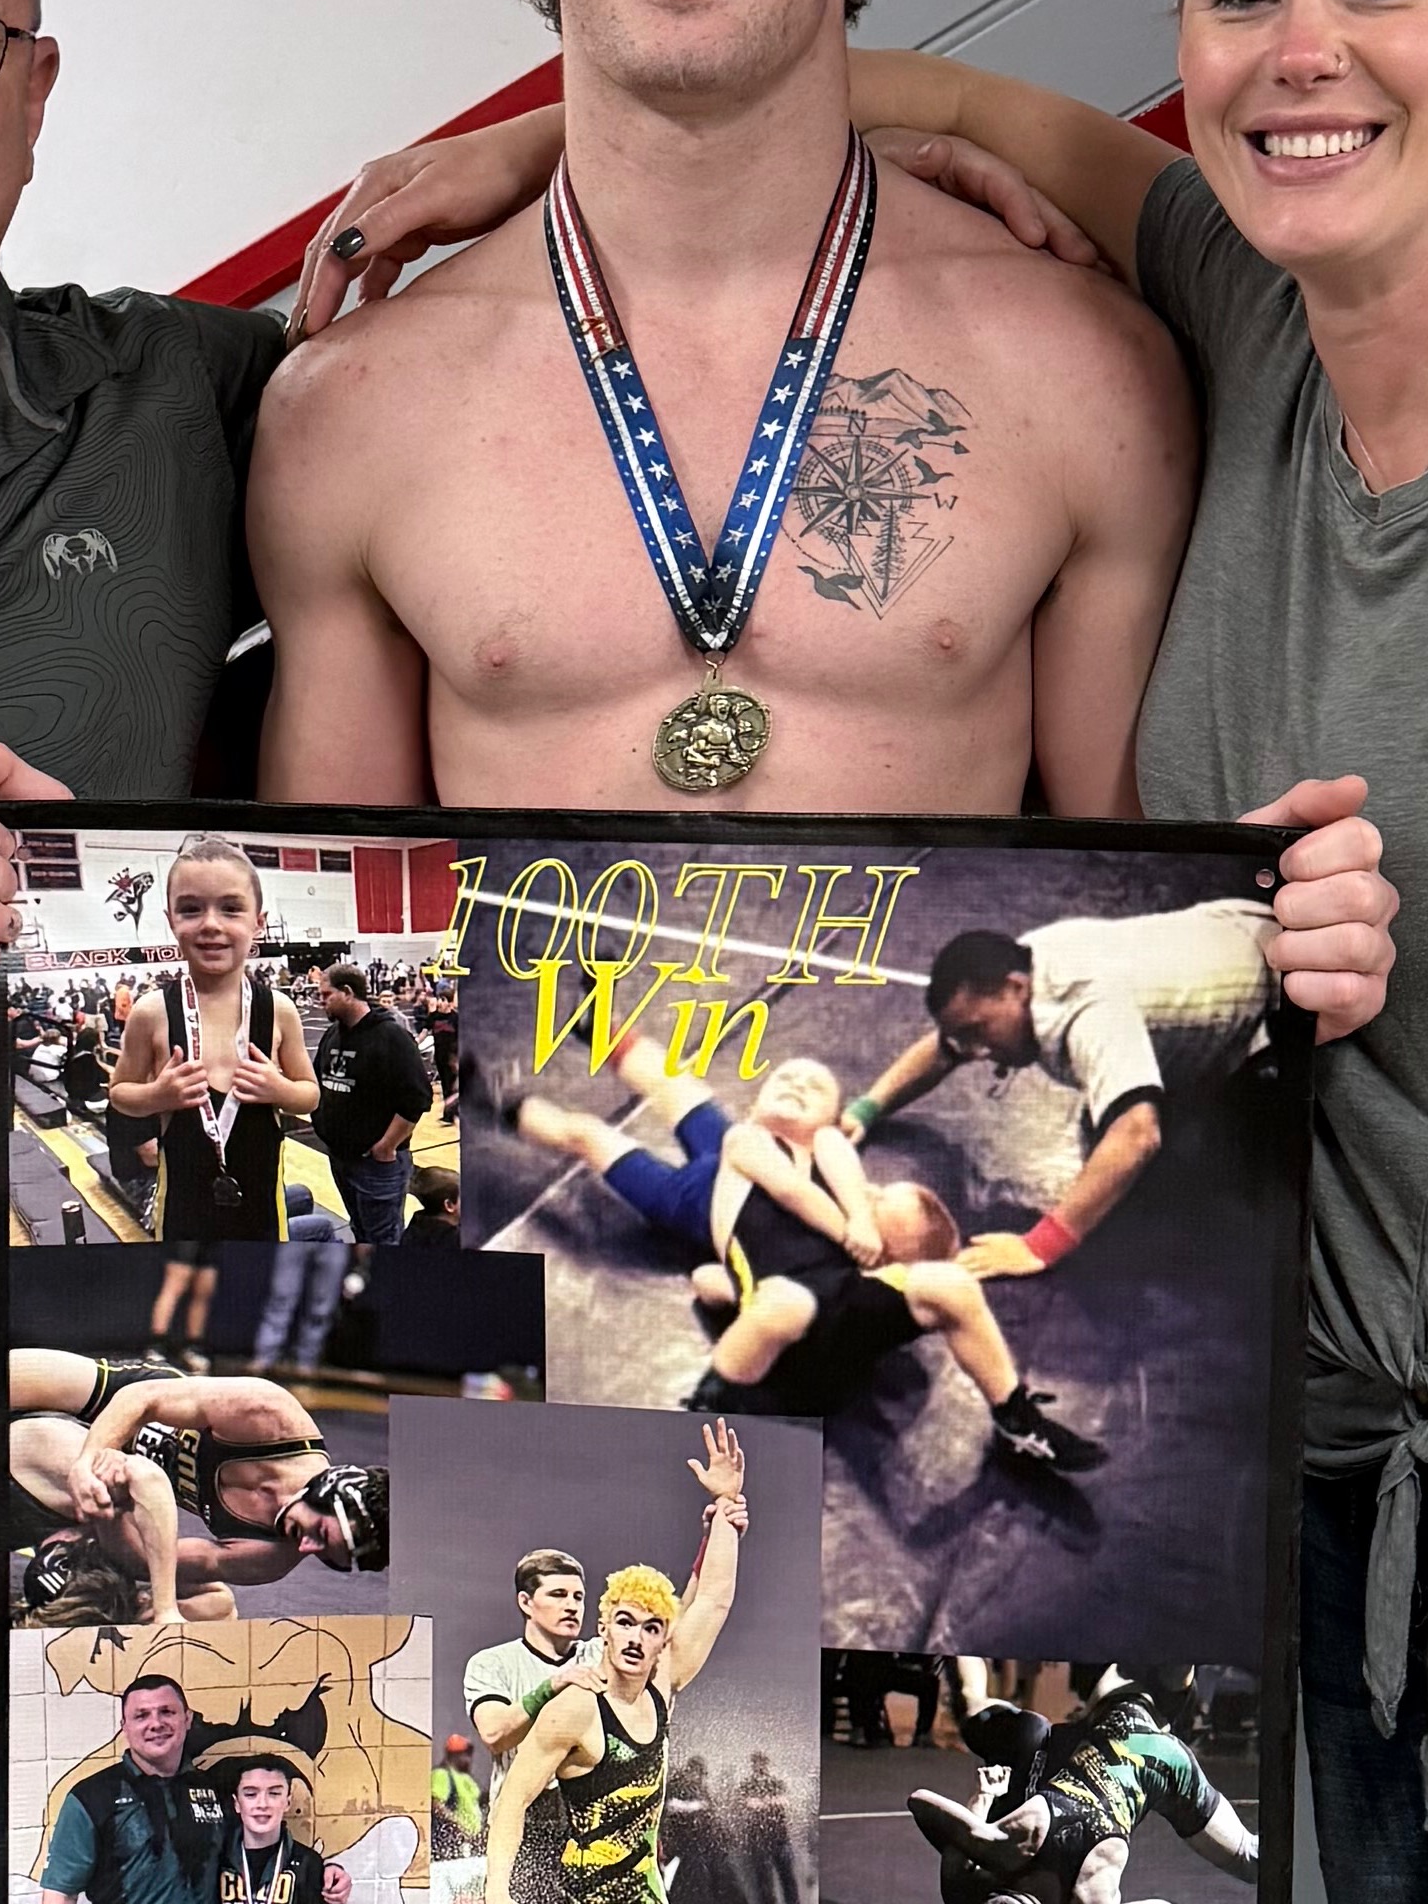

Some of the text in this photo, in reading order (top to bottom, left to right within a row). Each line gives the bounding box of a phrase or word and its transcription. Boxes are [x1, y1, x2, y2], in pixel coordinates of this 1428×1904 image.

[25, 947, 132, 972] BLACK
[422, 856, 920, 985] 100TH
[527, 958, 771, 1081] Win
